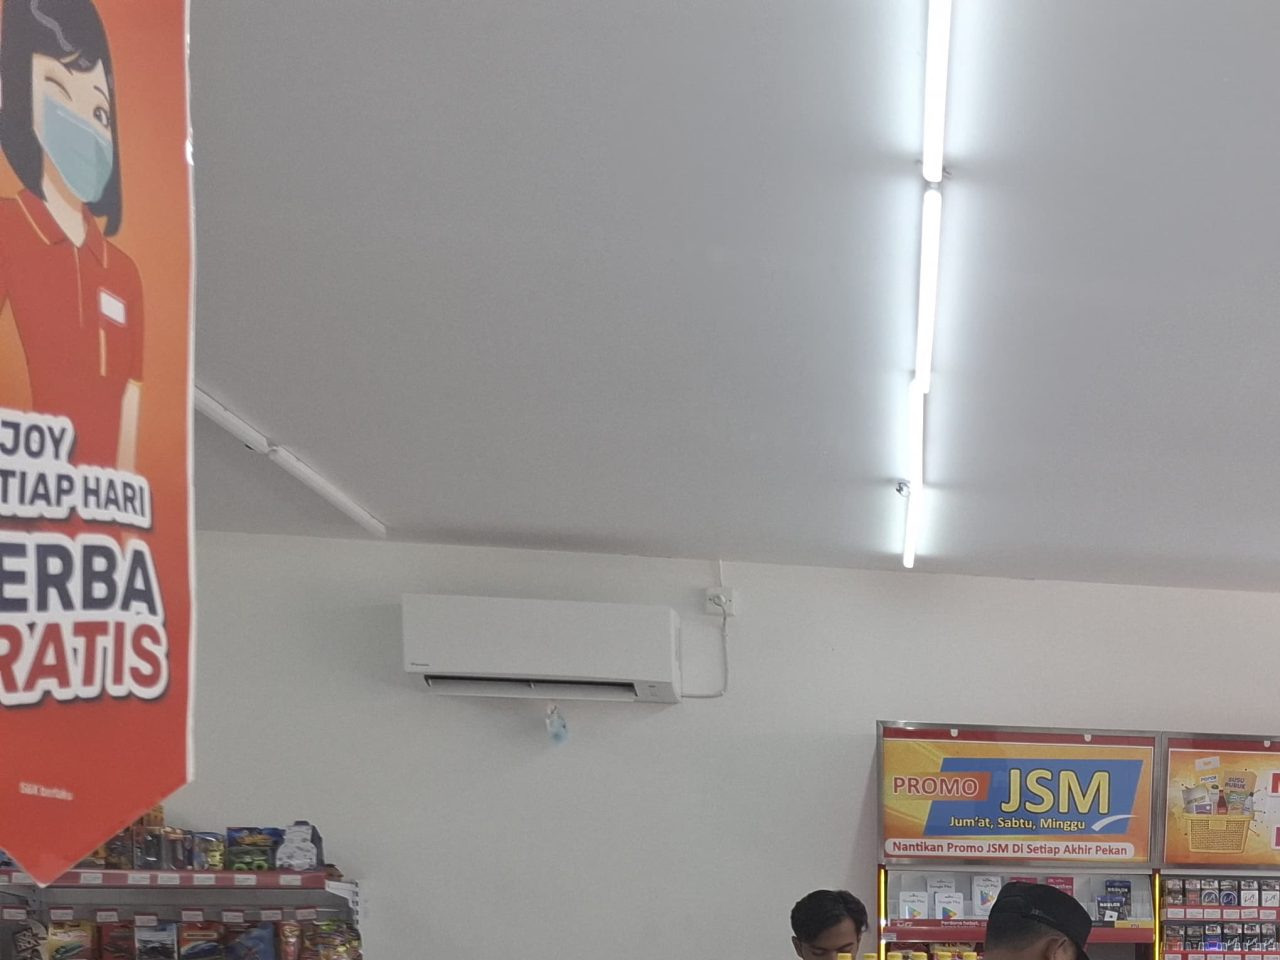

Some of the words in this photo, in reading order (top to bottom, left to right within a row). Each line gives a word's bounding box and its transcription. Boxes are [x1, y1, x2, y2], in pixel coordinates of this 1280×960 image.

[1, 420, 68, 460] JOY
[0, 469, 74, 508] TIAP
[84, 475, 146, 518] HARI
[0, 541, 158, 617] ERBA
[0, 620, 162, 694] RATIS
[892, 775, 979, 798] PROMO
[1000, 768, 1111, 815] JSM
[998, 817, 1037, 831] Sabtu,
[1040, 818, 1086, 833] Minggu
[892, 841, 944, 854] Nantikan
[946, 842, 984, 855] Promo
[986, 843, 1010, 855] JSM
[1011, 843, 1025, 855] Di
[1026, 843, 1061, 858] Setiap
[1063, 844, 1092, 856] Akhir
[1095, 845, 1128, 857] Pekan
